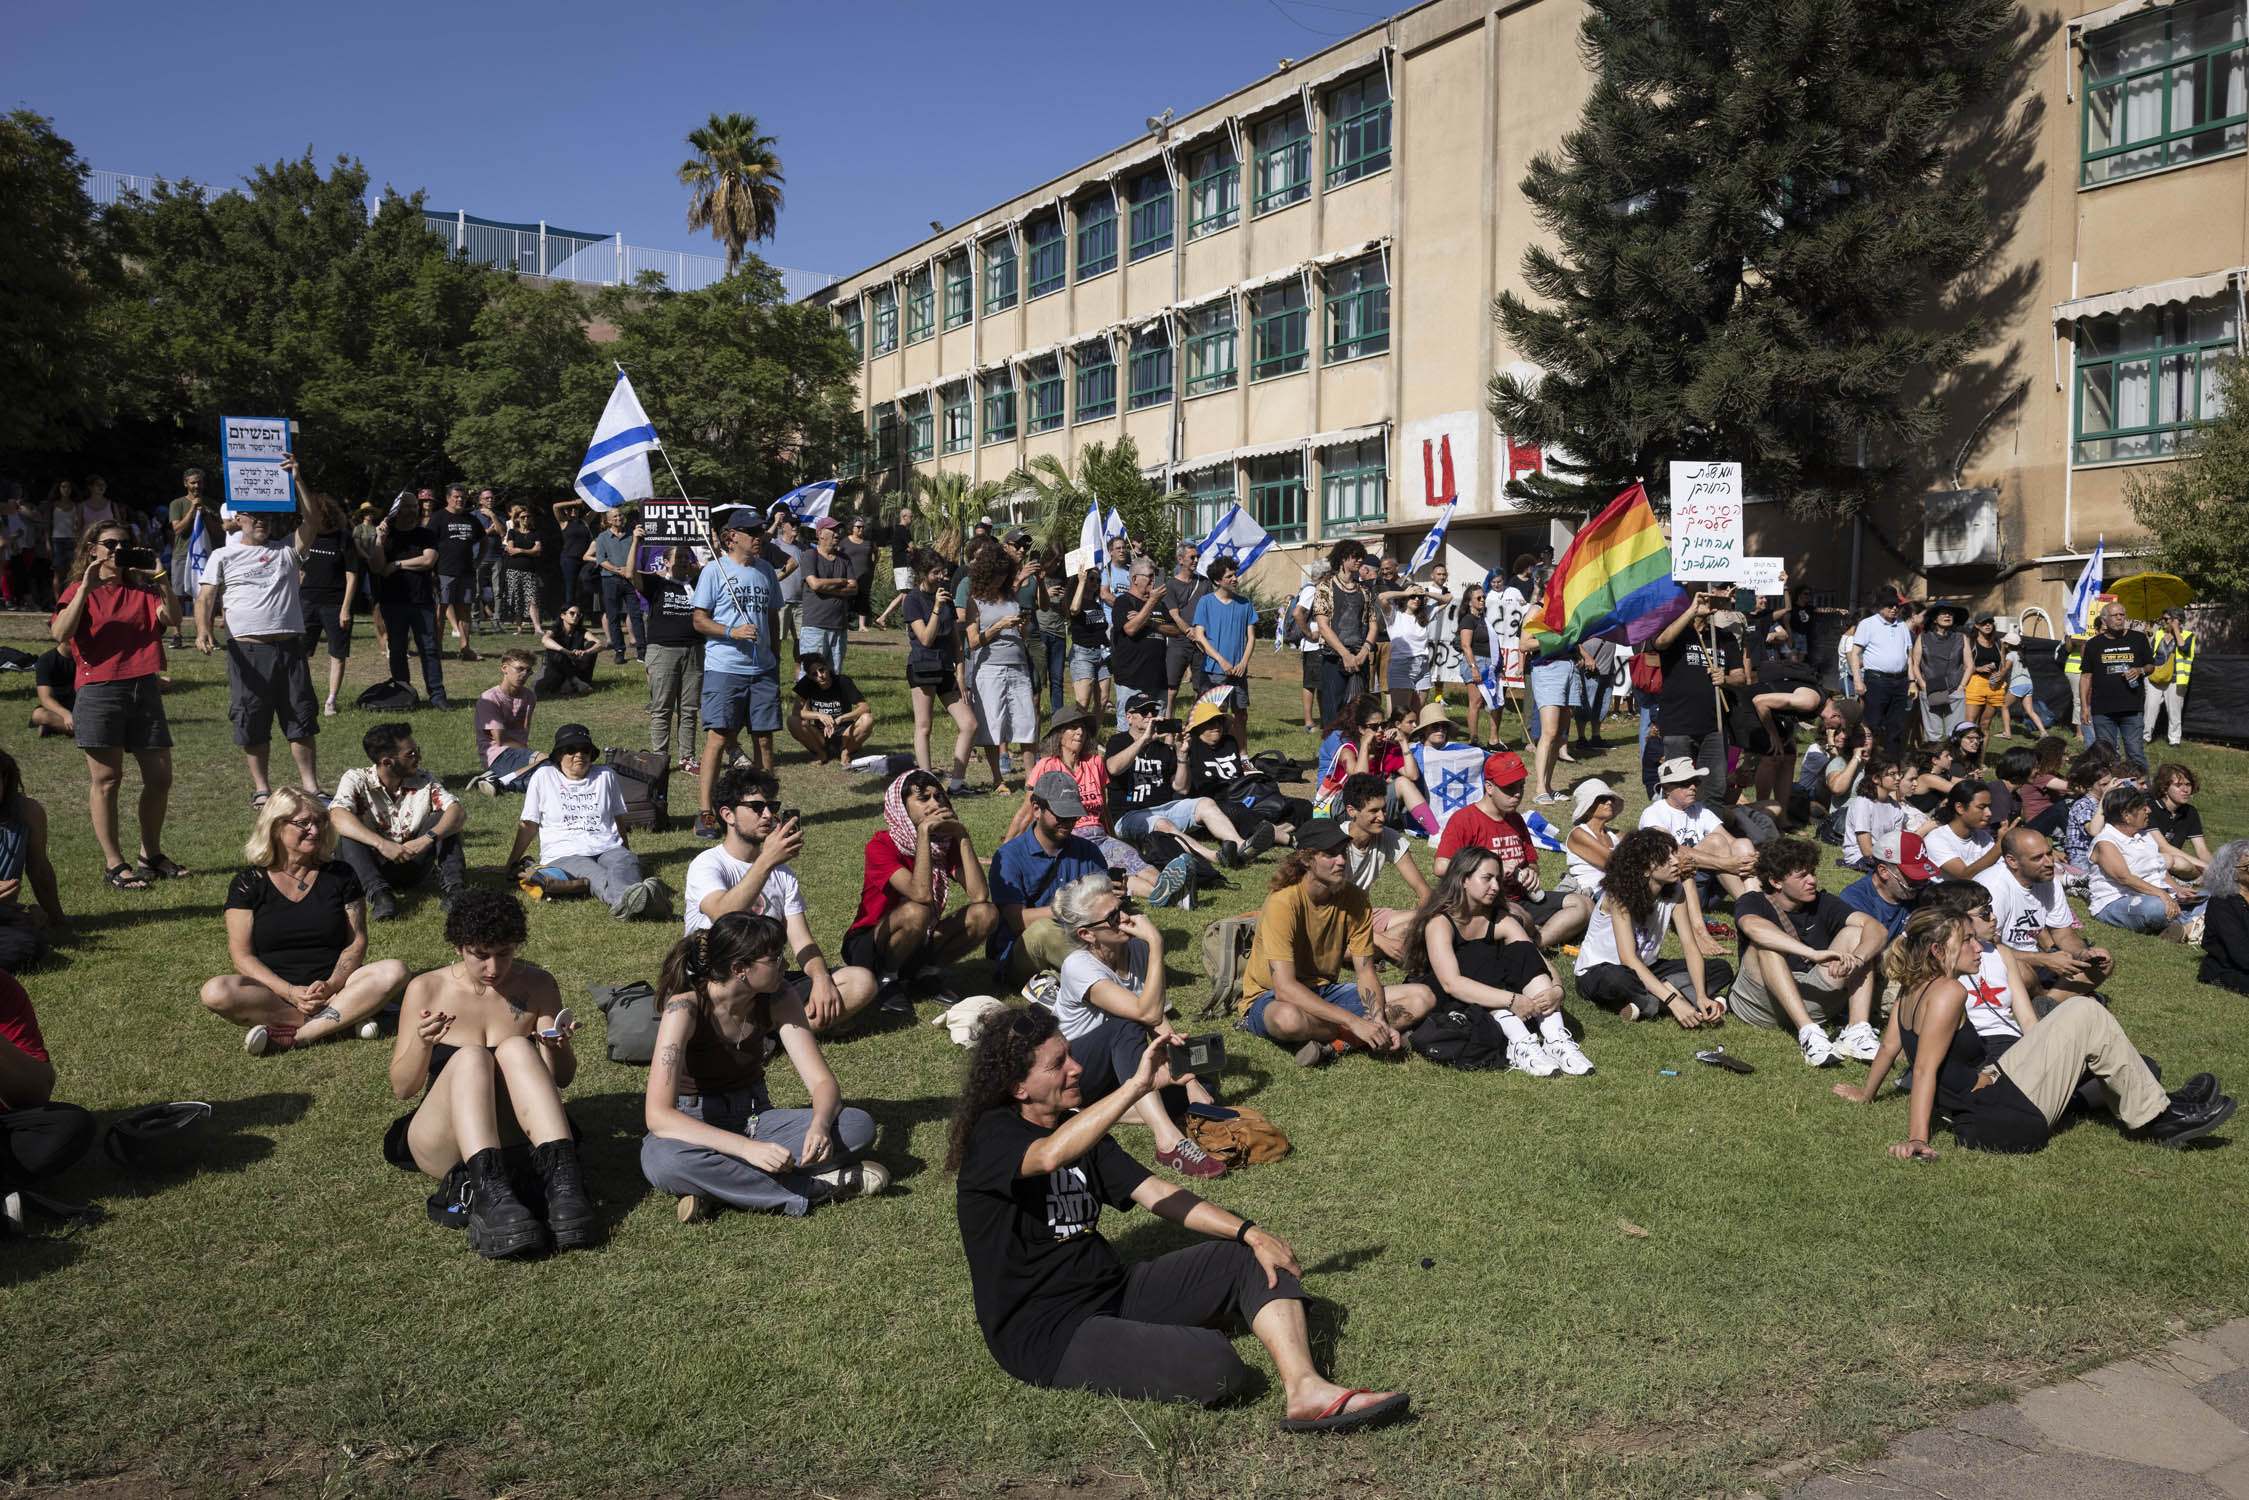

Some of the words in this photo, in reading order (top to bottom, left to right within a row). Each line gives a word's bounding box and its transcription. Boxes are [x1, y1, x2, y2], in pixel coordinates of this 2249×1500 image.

[229, 427, 280, 440] הפשיזם
[228, 442, 246, 452] אותך
[268, 443, 284, 452] אולי
[239, 467, 262, 478] לעולם
[264, 468, 280, 478] אבל
[1686, 463, 1734, 479] ממשלת
[243, 478, 260, 486] יכבה
[263, 478, 274, 486] לא
[234, 486, 250, 497] שלך
[253, 486, 271, 497] האור
[273, 487, 285, 496] את
[1687, 482, 1731, 502] החורבן
[644, 505, 710, 520] הכיבוש
[1676, 504, 1699, 516] את
[1705, 504, 1742, 516] הסירי
[666, 520, 710, 535] הורג
[1492, 836, 1520, 848] הודים
